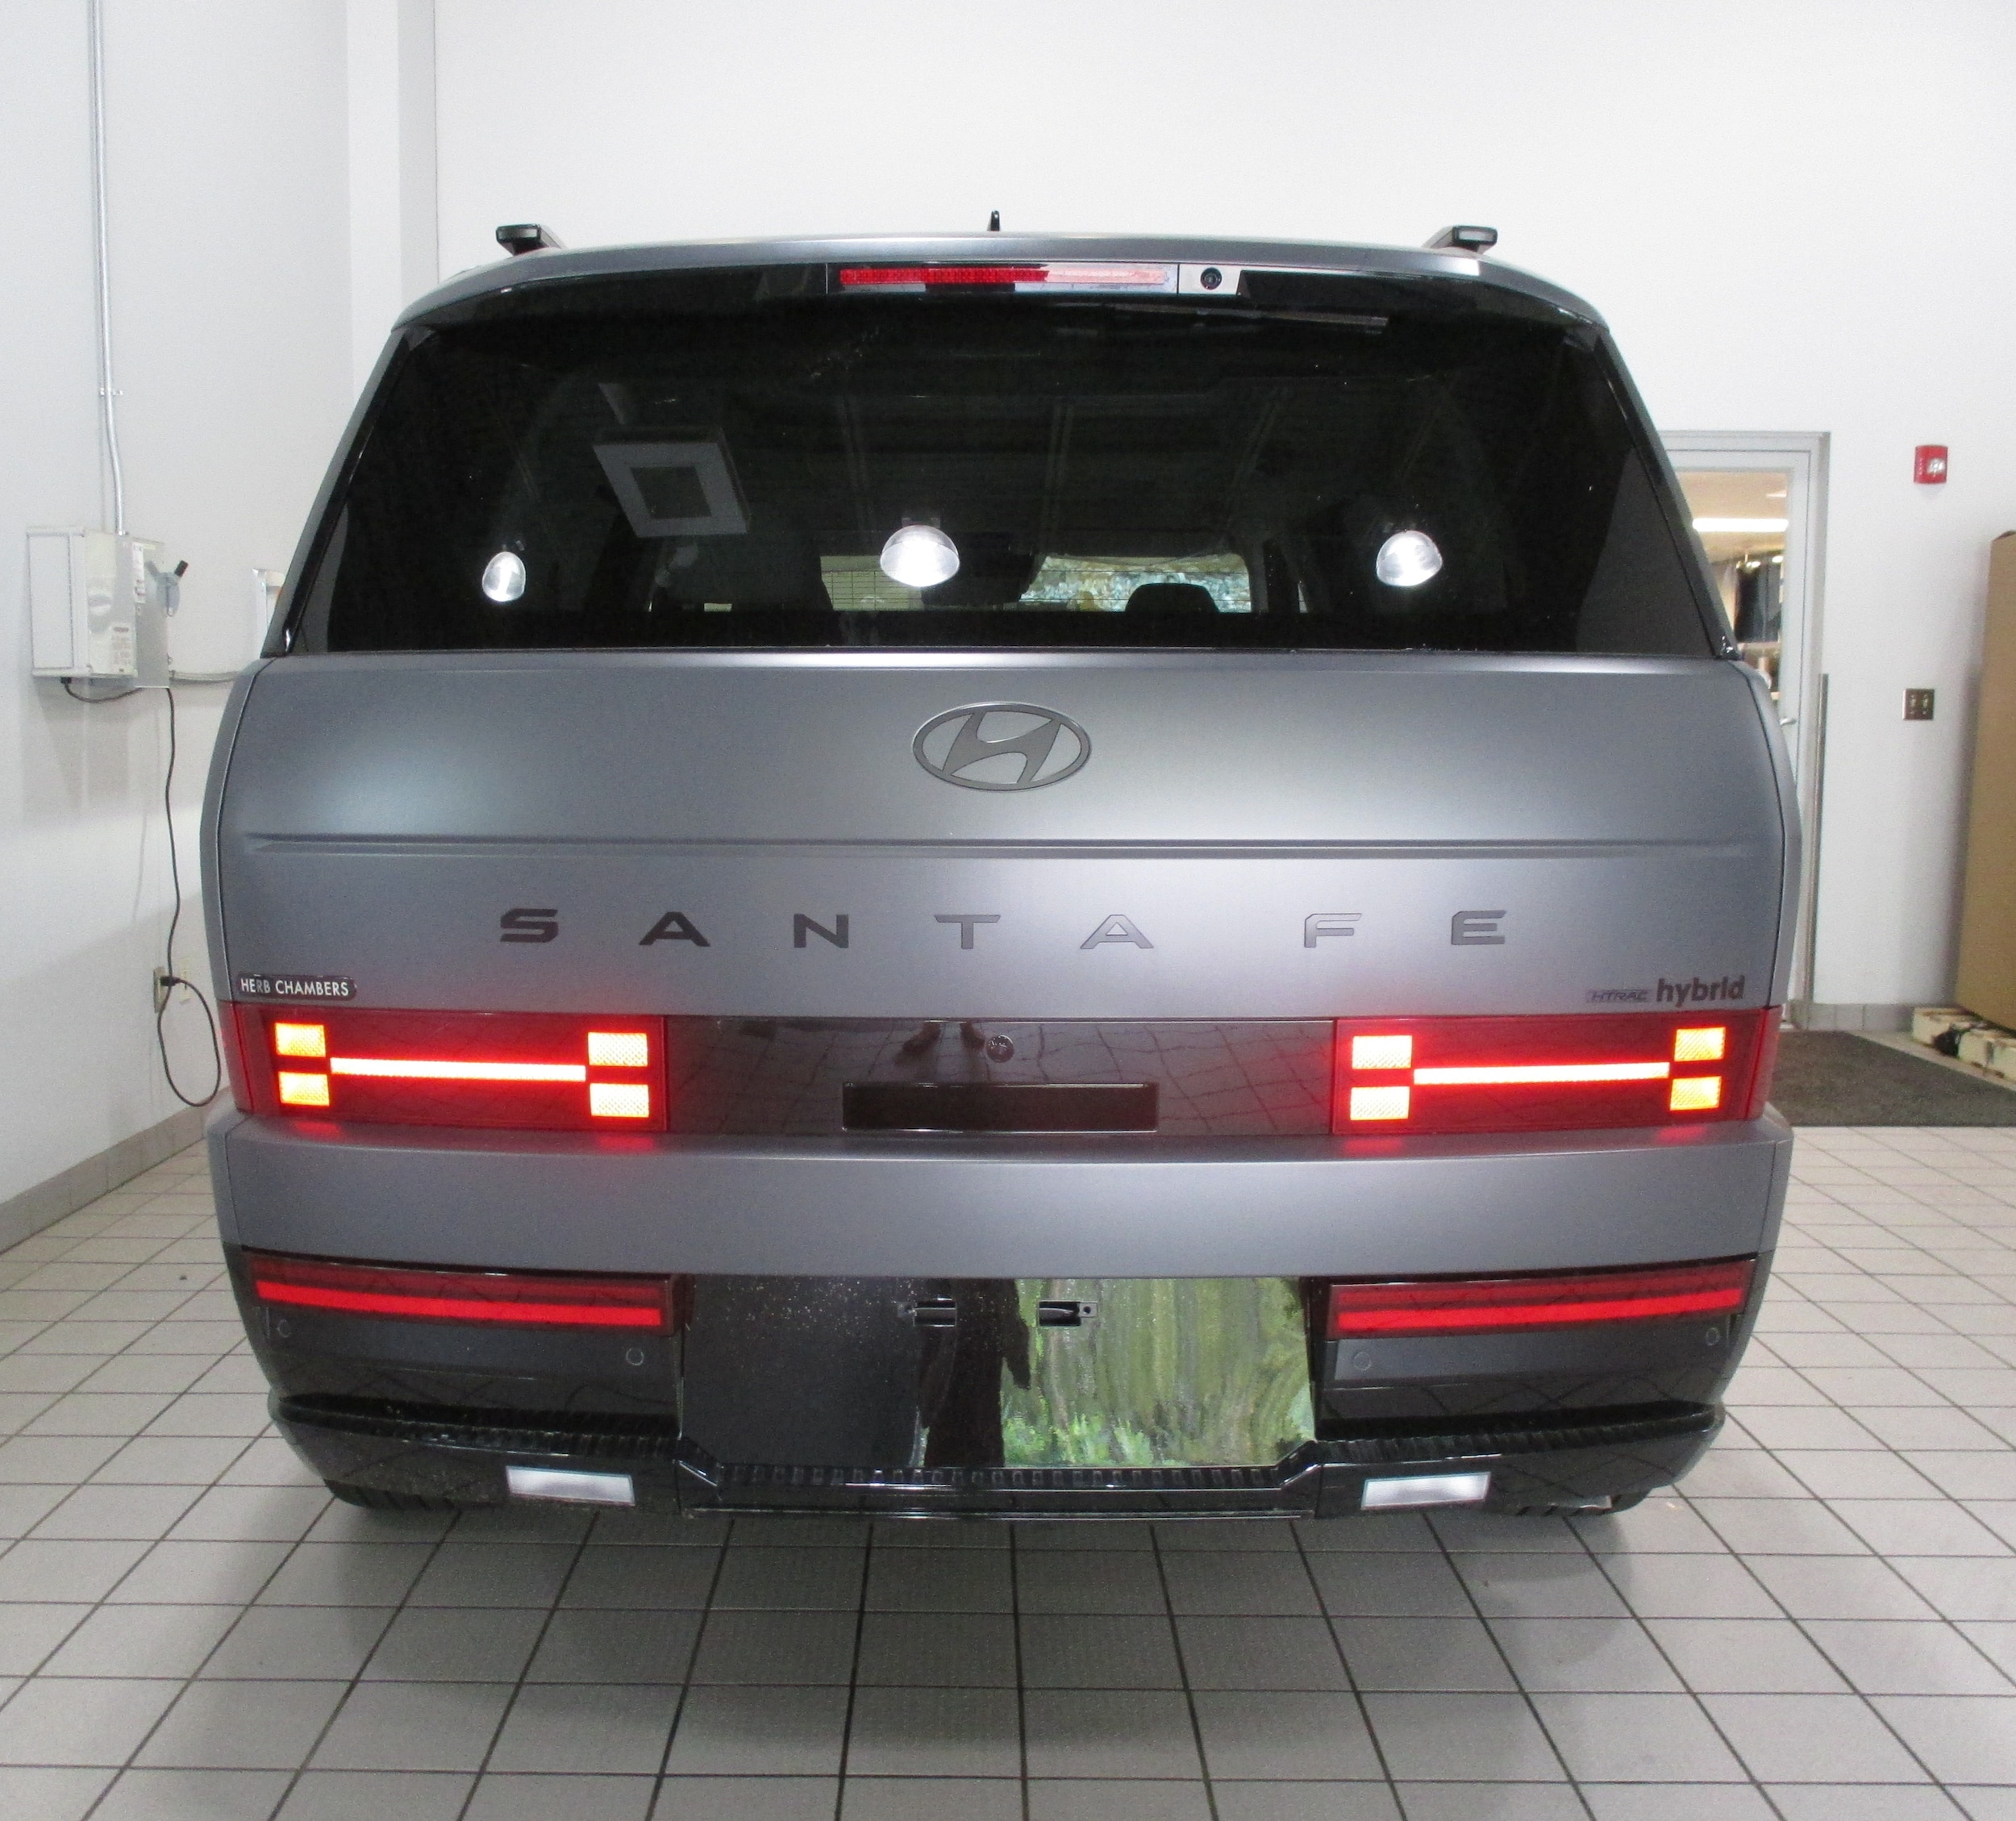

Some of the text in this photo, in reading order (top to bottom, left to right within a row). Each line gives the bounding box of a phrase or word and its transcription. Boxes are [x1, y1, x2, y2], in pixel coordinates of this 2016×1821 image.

[500, 907, 1507, 950] SANTA FE
[240, 978, 349, 996] HERB CHAMBERS
[1656, 974, 1745, 1007] hybrid
